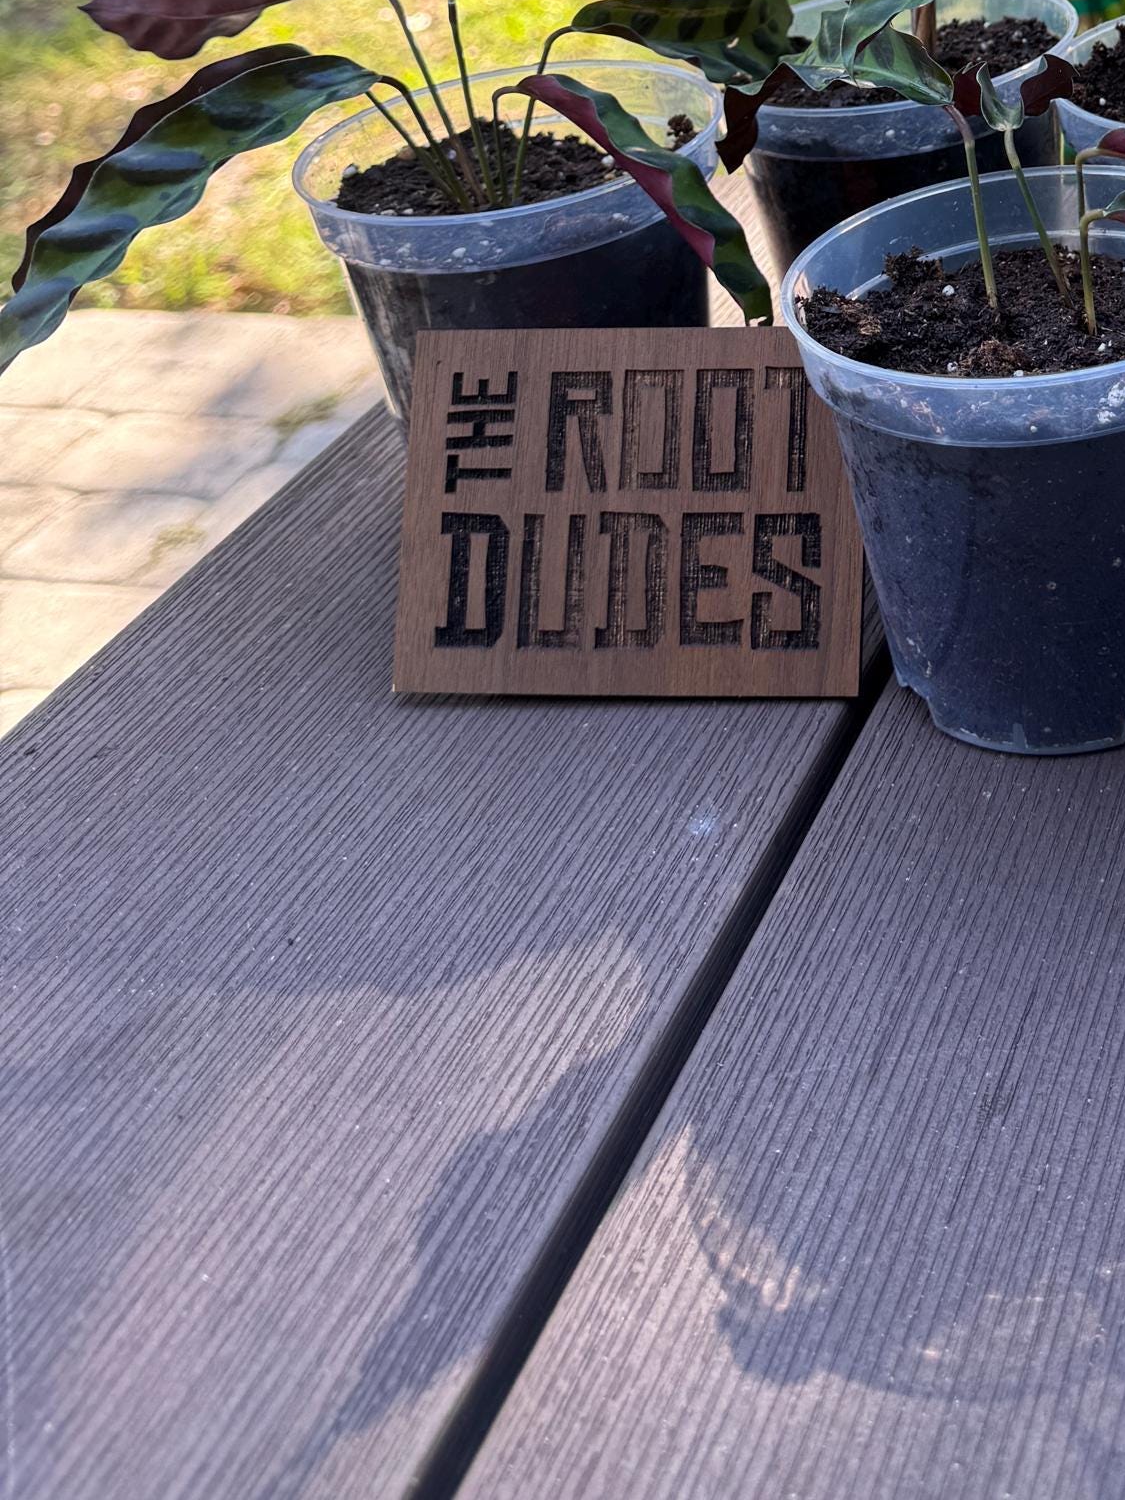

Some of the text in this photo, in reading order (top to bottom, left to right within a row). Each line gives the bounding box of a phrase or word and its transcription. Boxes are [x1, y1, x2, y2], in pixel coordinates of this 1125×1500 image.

[444, 370, 518, 494] THE
[545, 366, 809, 493] ROOT
[434, 511, 822, 650] DUDES
